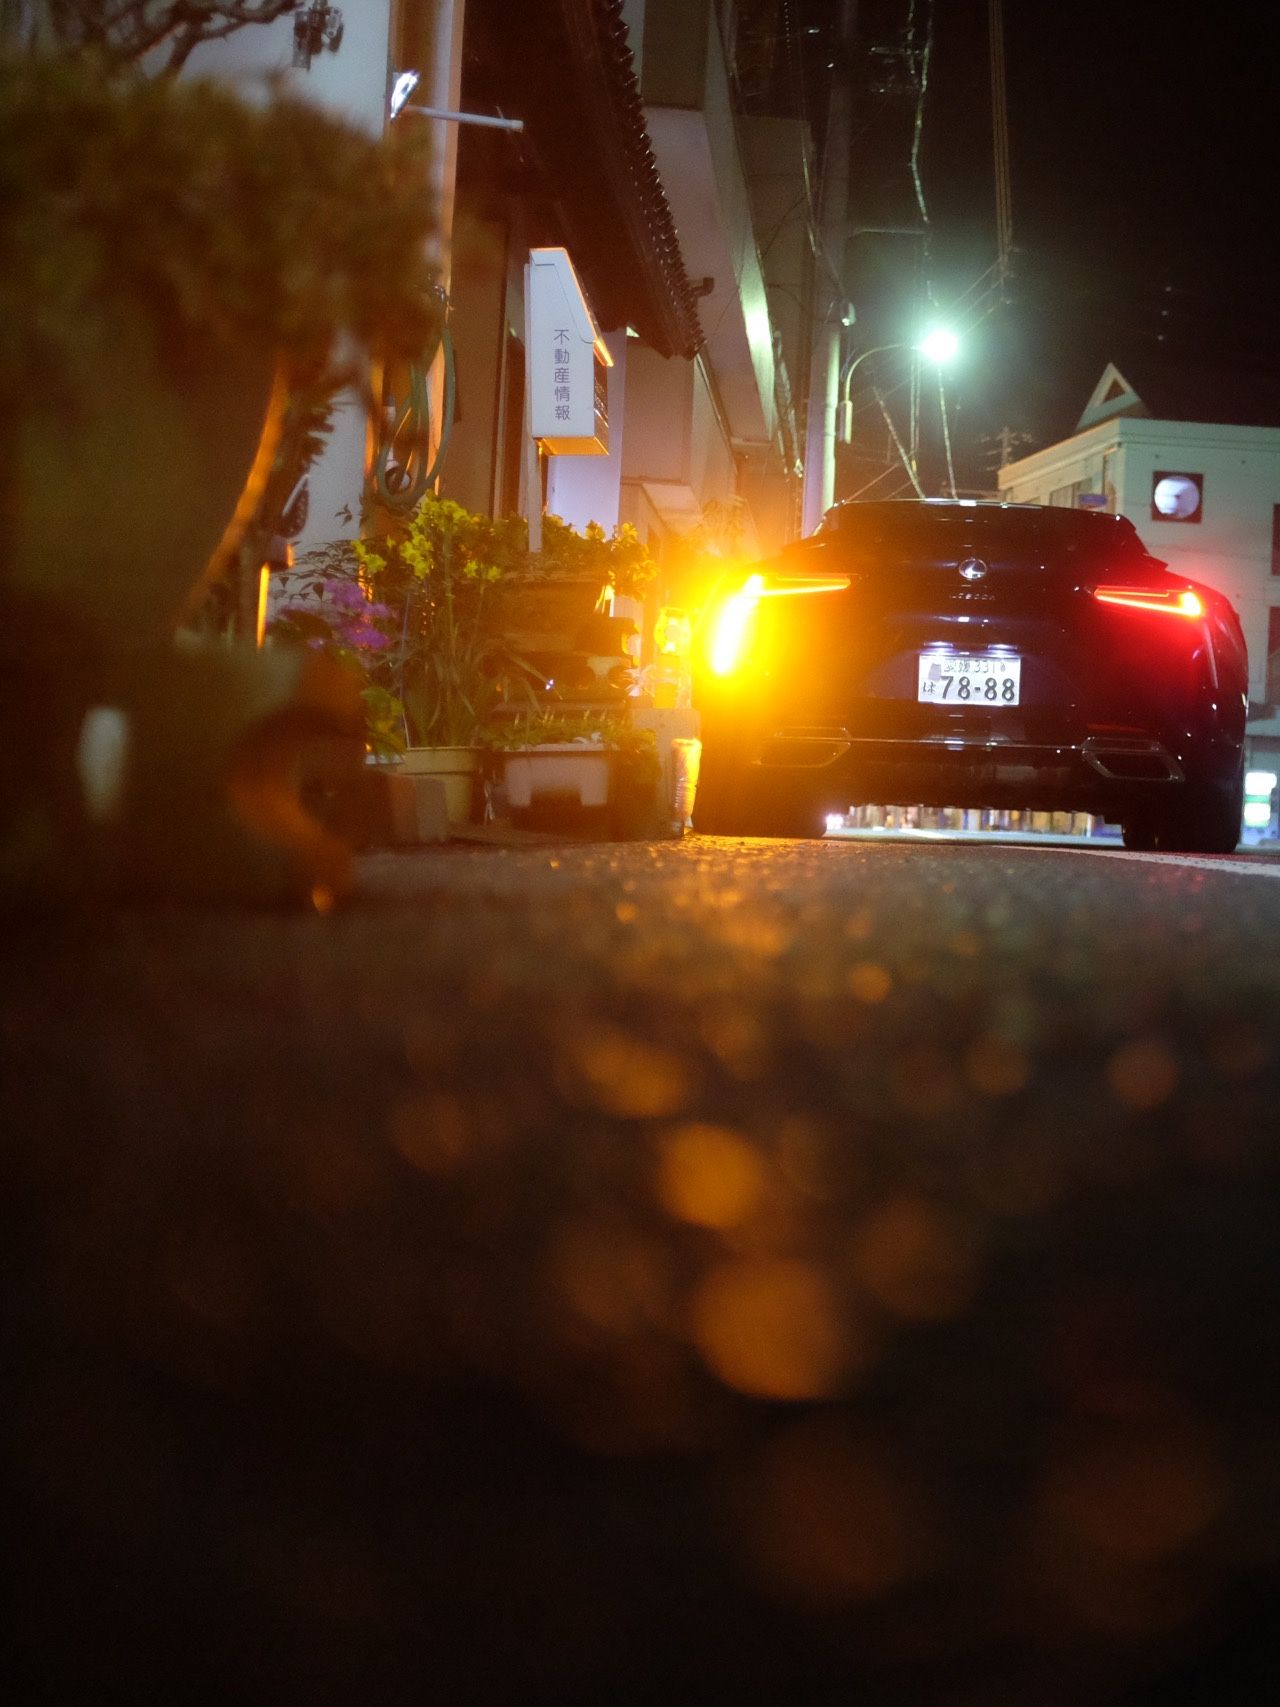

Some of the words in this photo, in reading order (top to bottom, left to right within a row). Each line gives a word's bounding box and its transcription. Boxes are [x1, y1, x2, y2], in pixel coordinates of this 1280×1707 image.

[553, 328, 571, 422] 不動産情報
[940, 675, 1015, 702] 78-88
